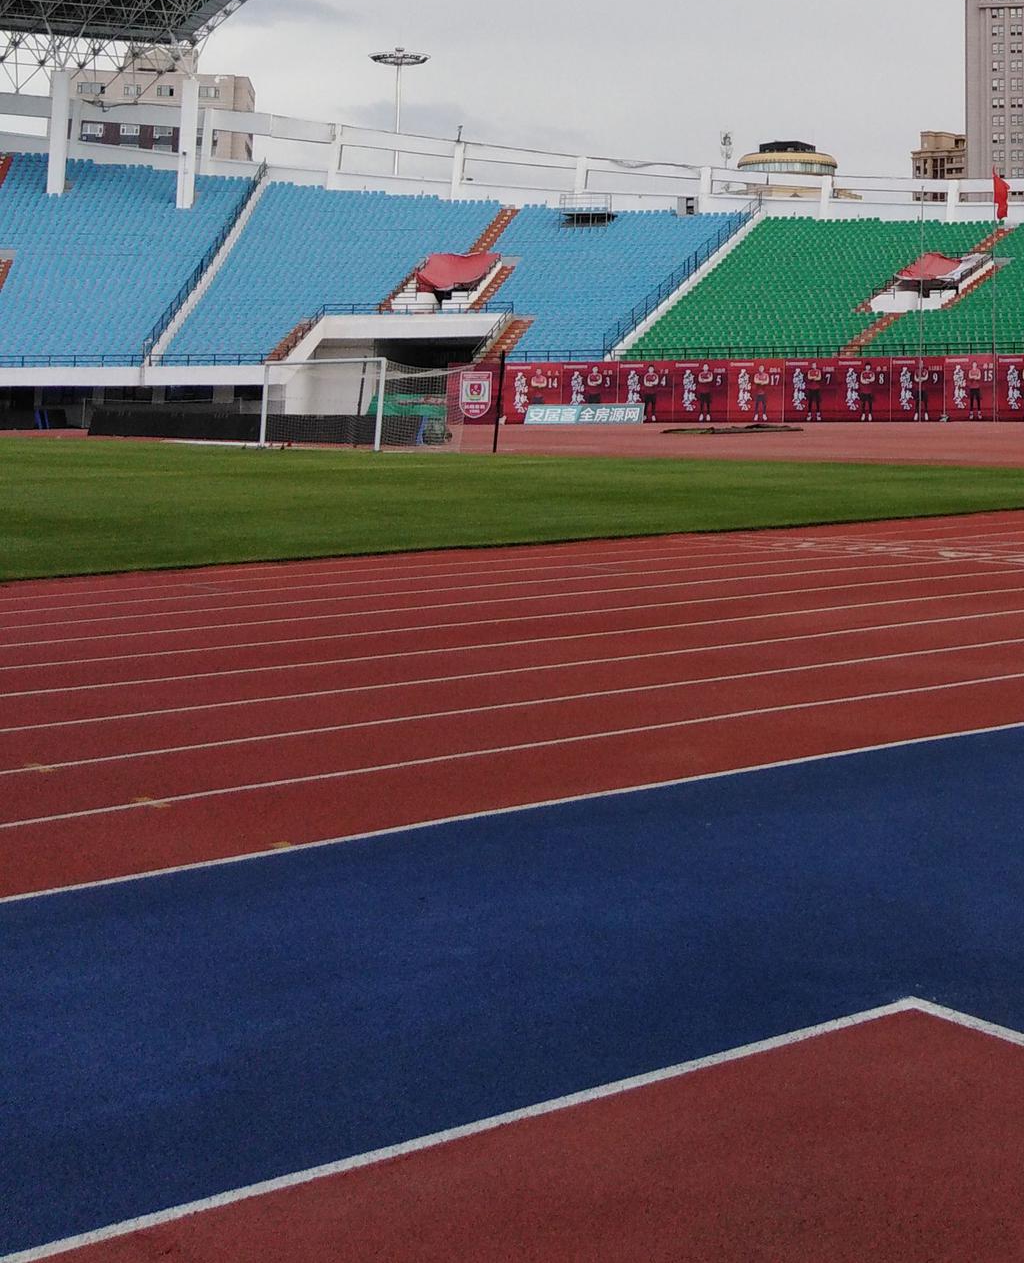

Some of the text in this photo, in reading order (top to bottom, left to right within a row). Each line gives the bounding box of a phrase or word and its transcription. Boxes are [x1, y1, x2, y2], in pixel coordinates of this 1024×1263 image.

[660, 376, 666, 386] 4
[716, 375, 722, 385] 5
[771, 375, 779, 385] 17
[825, 374, 831, 384] 7
[878, 373, 884, 384] 8
[932, 373, 938, 383] 9
[985, 371, 993, 382] 15
[548, 378, 558, 388] 14
[605, 377, 611, 387] 3
[579, 408, 641, 422] 全房源网
